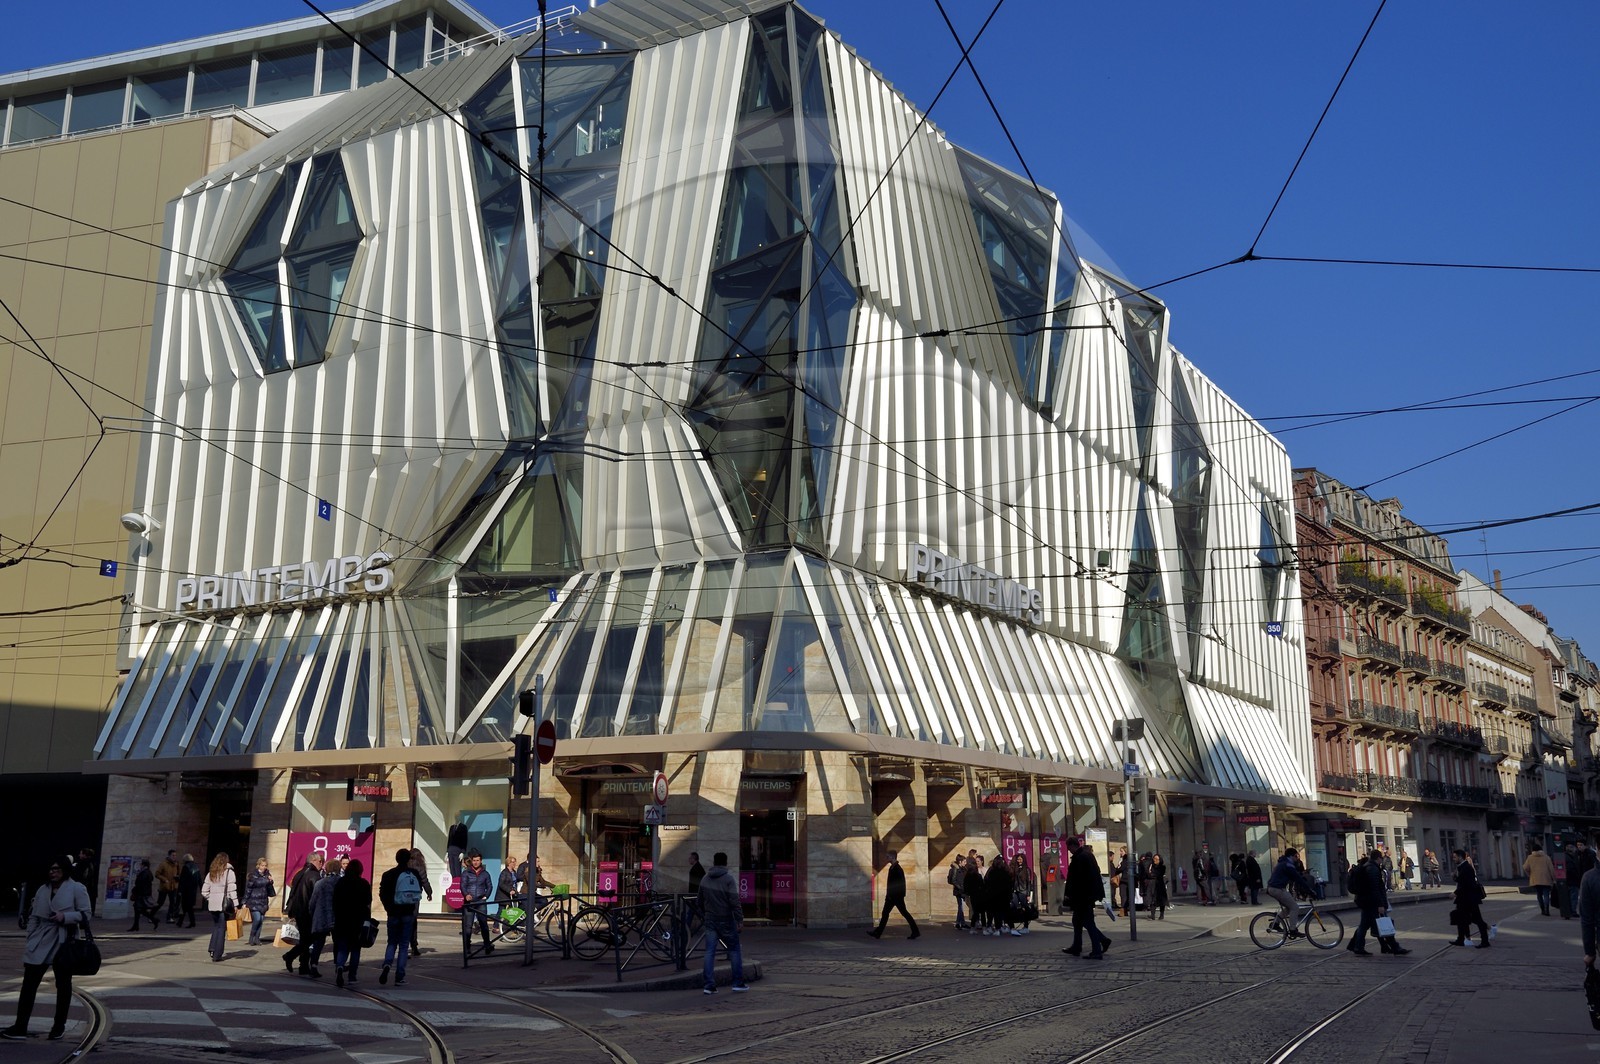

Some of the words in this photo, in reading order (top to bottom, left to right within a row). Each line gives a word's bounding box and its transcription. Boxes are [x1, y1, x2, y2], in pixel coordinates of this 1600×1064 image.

[322, 505, 327, 515] 2
[106, 564, 112, 573] 2
[175, 551, 394, 614] PRINTEMPS
[906, 541, 1044, 626] PRINTEMPS
[603, 782, 653, 793] PRINTEMP
[334, 844, 352, 852] -30%
[605, 877, 612, 890] 8
[740, 878, 748, 891] 8
